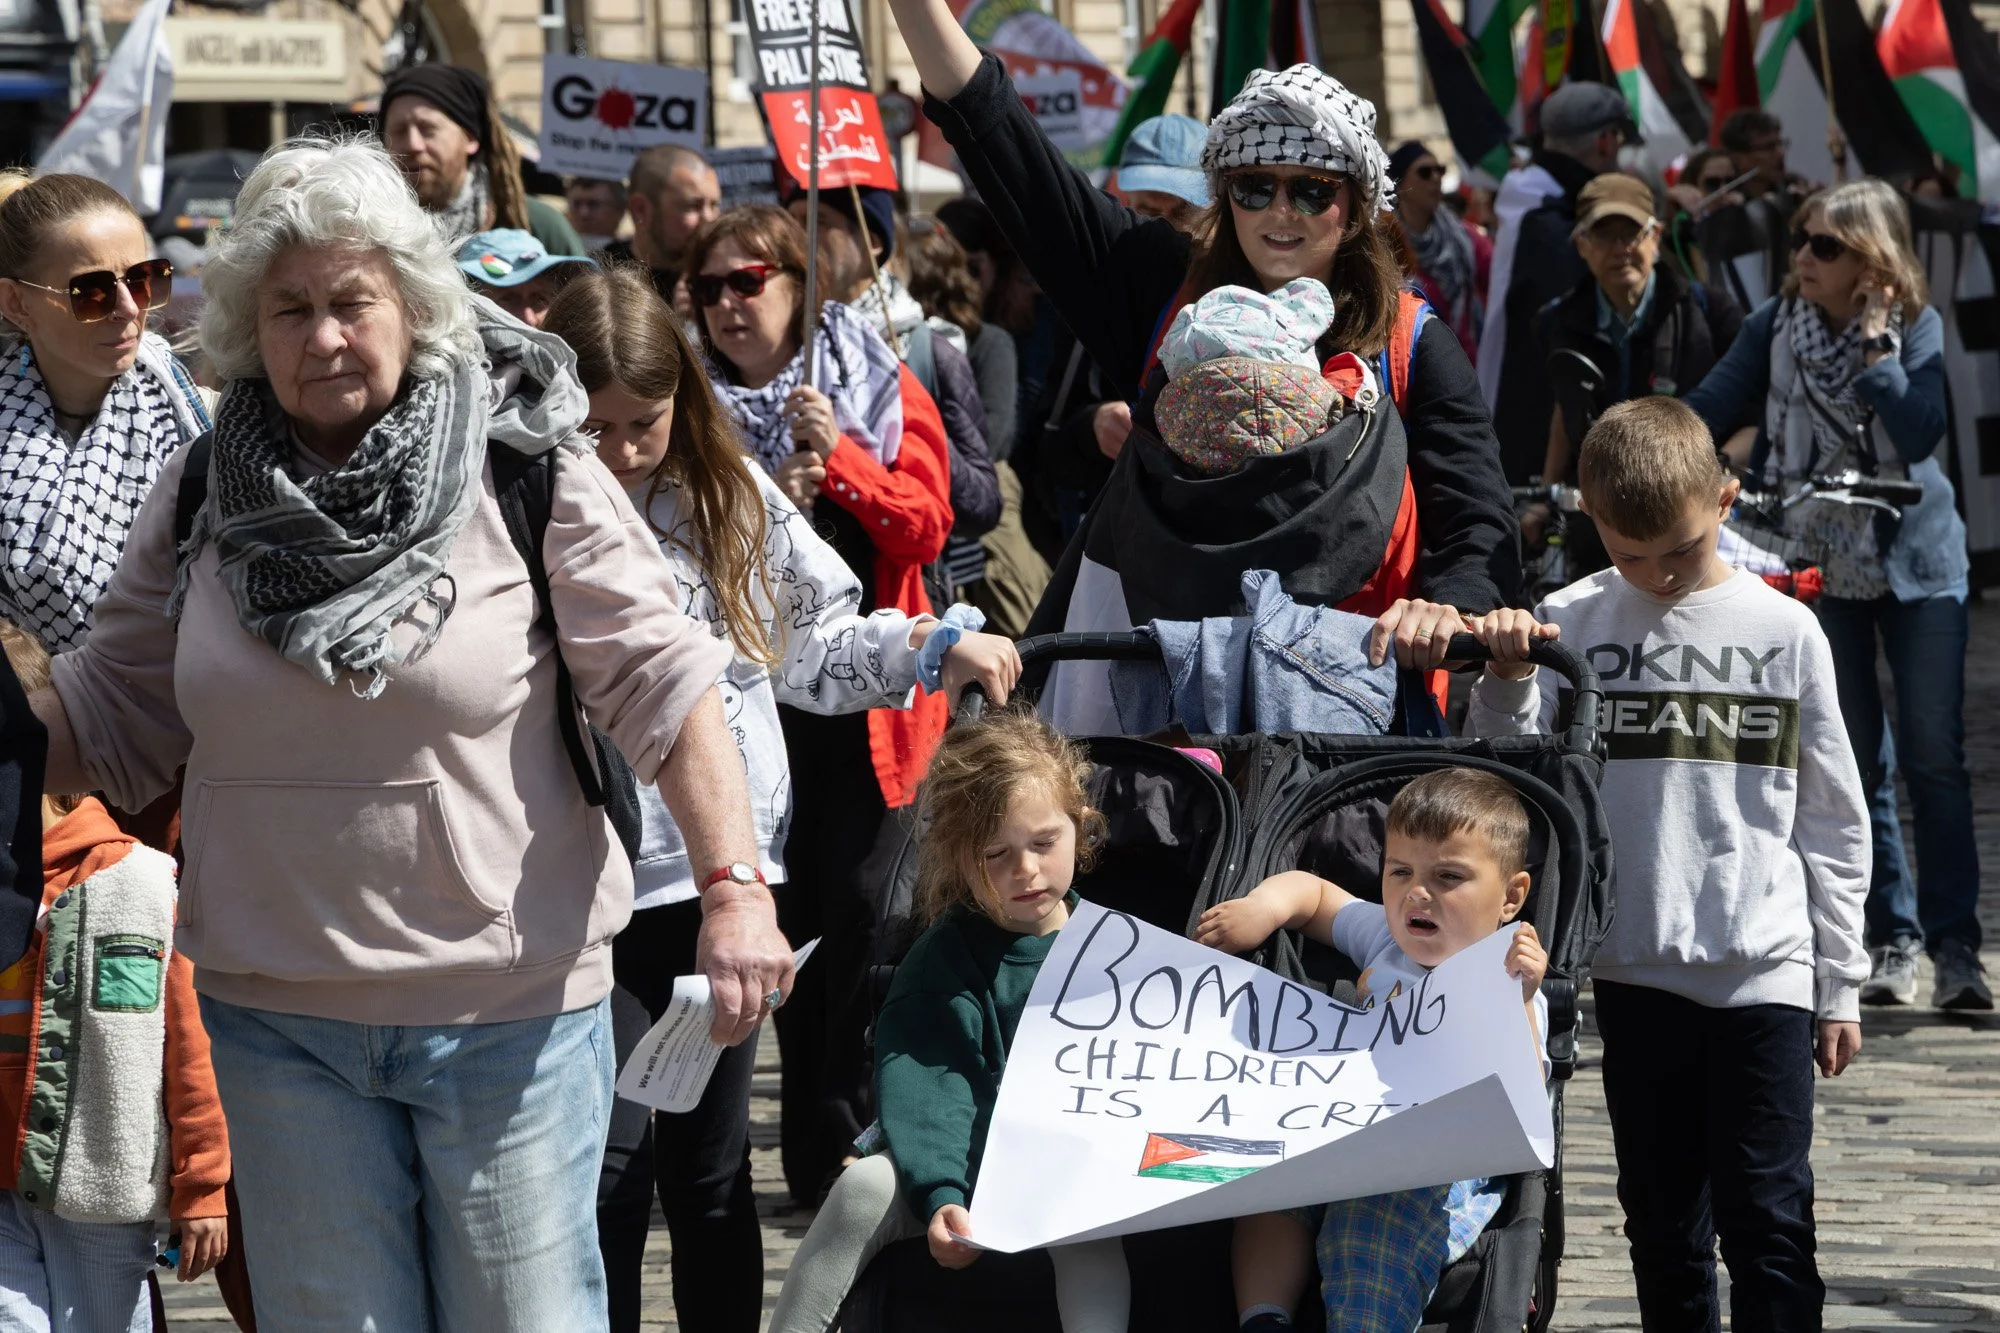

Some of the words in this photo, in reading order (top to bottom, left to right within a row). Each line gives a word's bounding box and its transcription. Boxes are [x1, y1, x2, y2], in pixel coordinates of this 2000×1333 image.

[752, 0, 850, 32] FREEOM
[553, 75, 698, 132] Gza
[1586, 643, 1786, 684] DKNY
[1050, 909, 1446, 1053] BOMBING
[638, 1073, 651, 1089] We
[646, 1055, 659, 1073] will
[654, 1040, 666, 1055] not
[662, 1017, 684, 1043] tolerate
[1054, 1036, 1346, 1087] CHILDREN
[1062, 1085, 1143, 1118] IS
[1197, 1094, 1244, 1127] A
[1277, 1102, 1419, 1131] CRI
